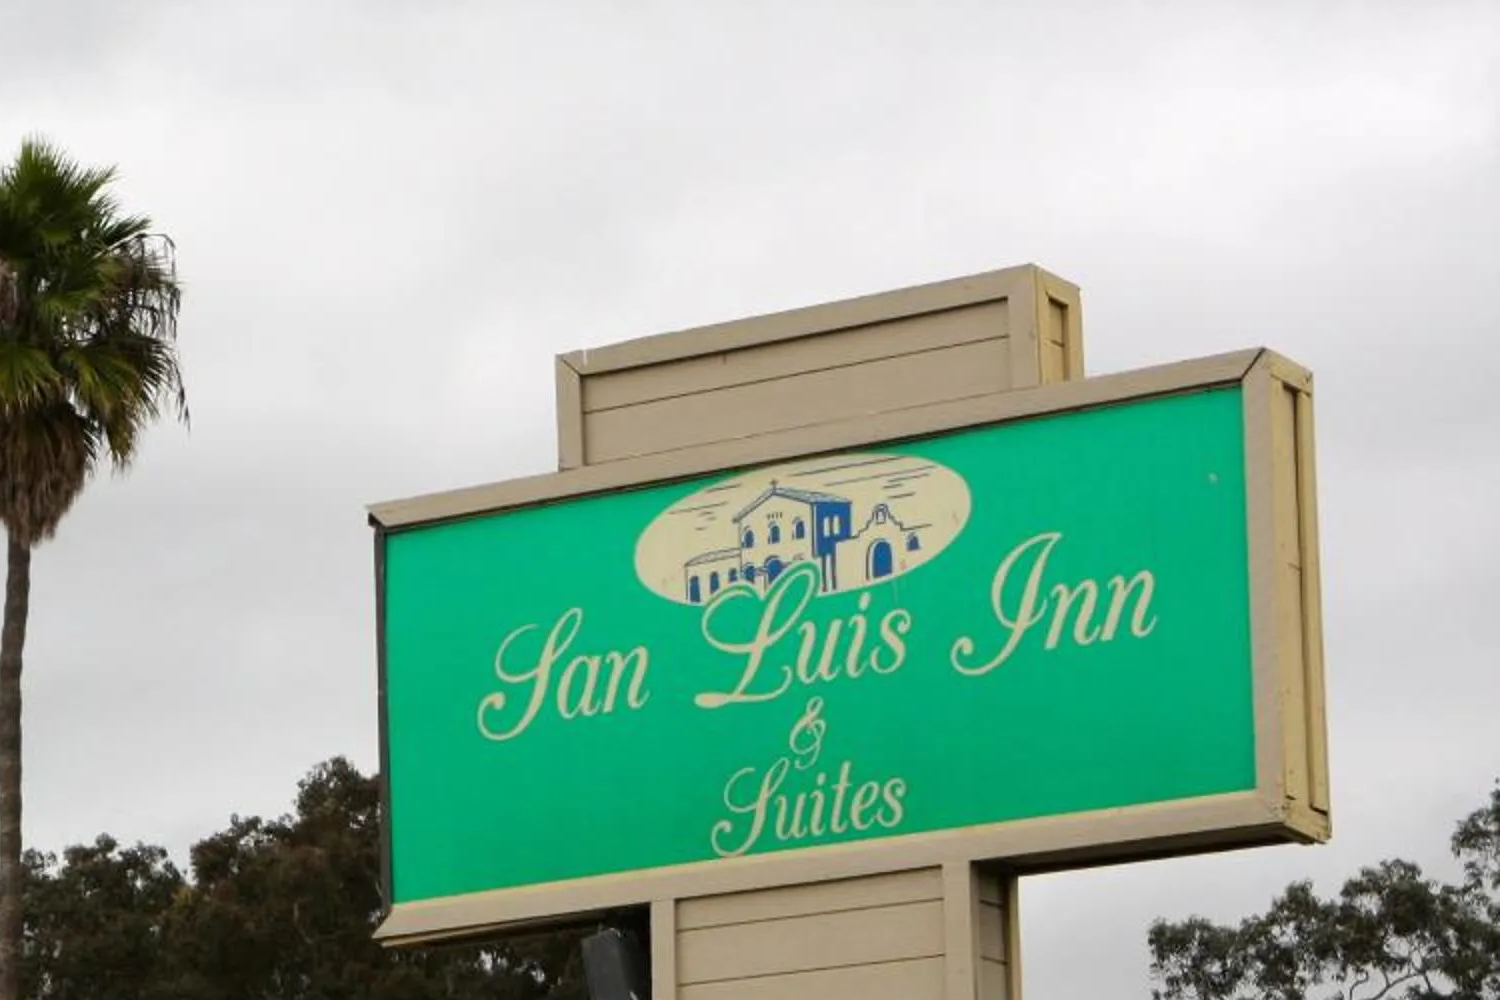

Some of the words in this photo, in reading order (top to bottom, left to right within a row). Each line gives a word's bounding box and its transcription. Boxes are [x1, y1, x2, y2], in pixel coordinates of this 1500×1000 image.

[477, 606, 651, 741] San
[694, 567, 913, 709] Luis
[950, 532, 1157, 677] Inn
[788, 696, 827, 770] &
[711, 757, 907, 858] Suites
